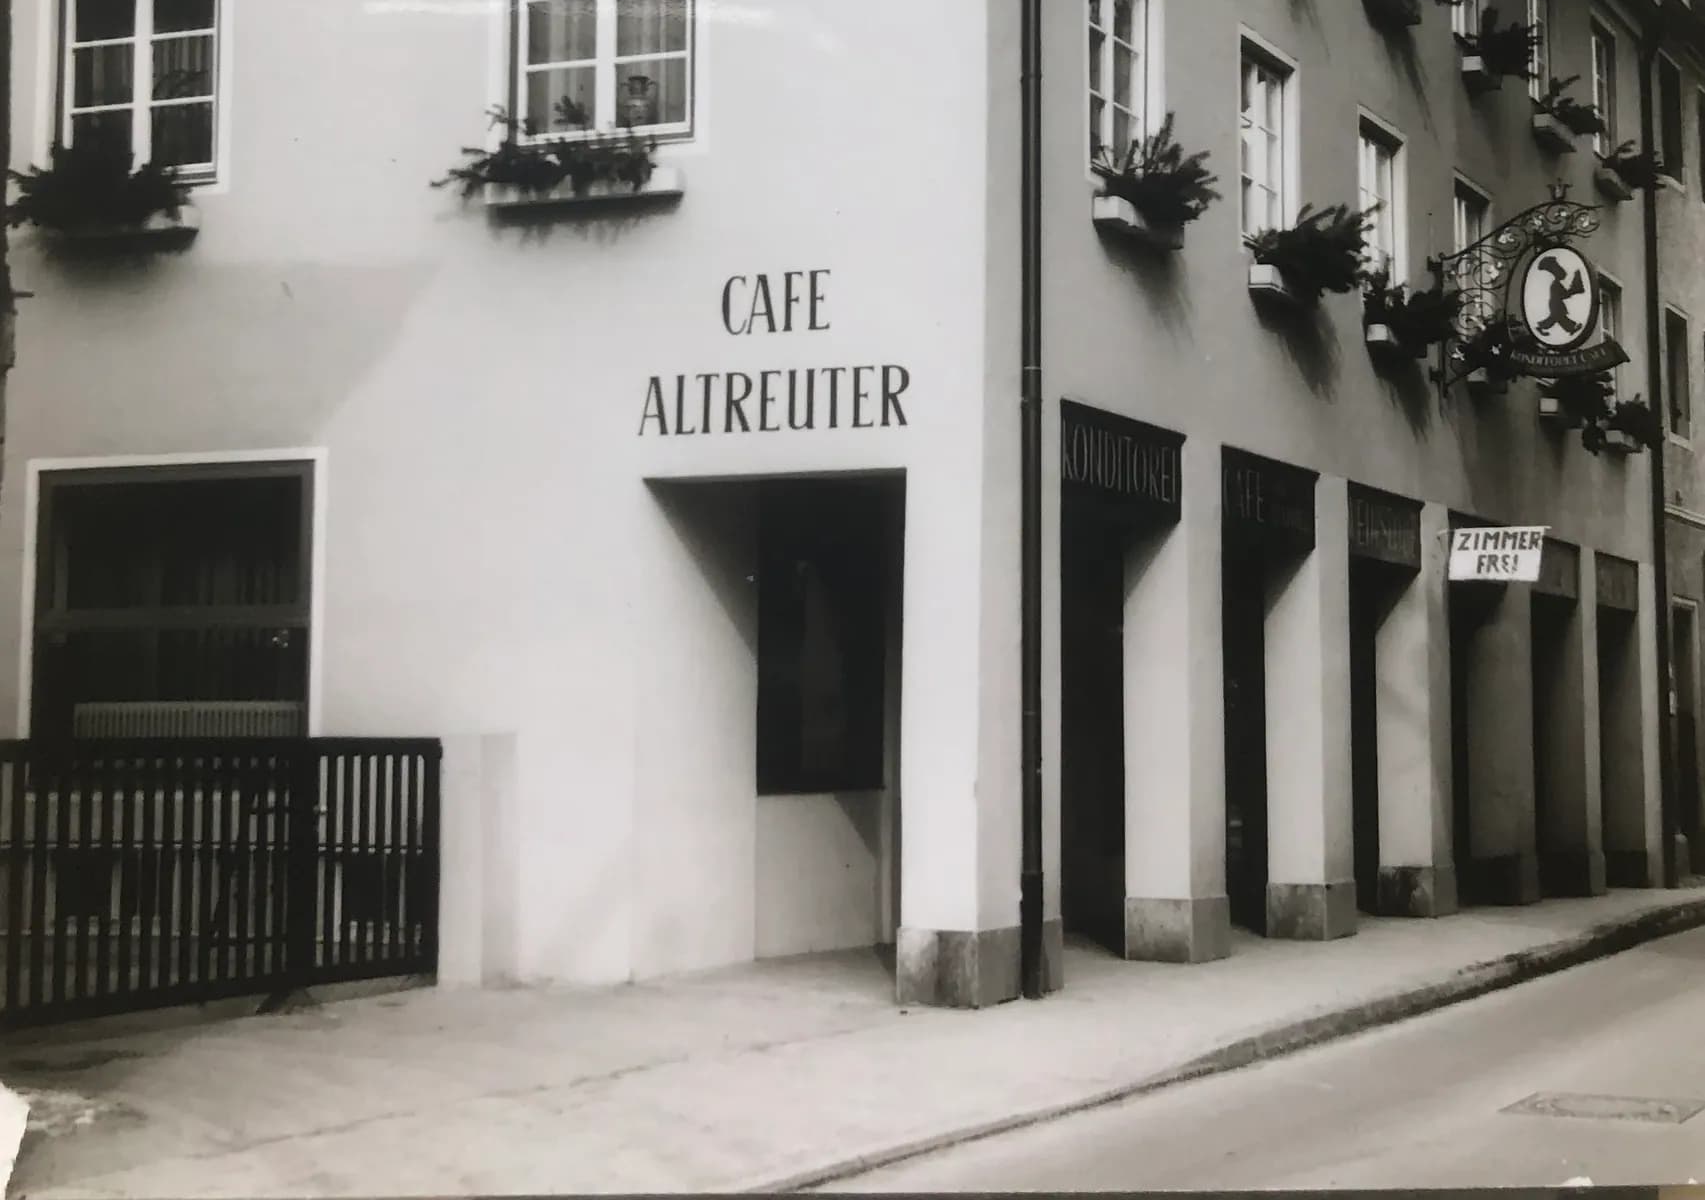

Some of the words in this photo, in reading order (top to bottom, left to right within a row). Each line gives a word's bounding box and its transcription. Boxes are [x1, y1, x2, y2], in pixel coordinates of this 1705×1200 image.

[721, 269, 831, 335] CAFE
[638, 365, 910, 436] ALTREUTER
[1062, 417, 1176, 504] KONDITOREI
[1457, 531, 1542, 551] ZIMMER
